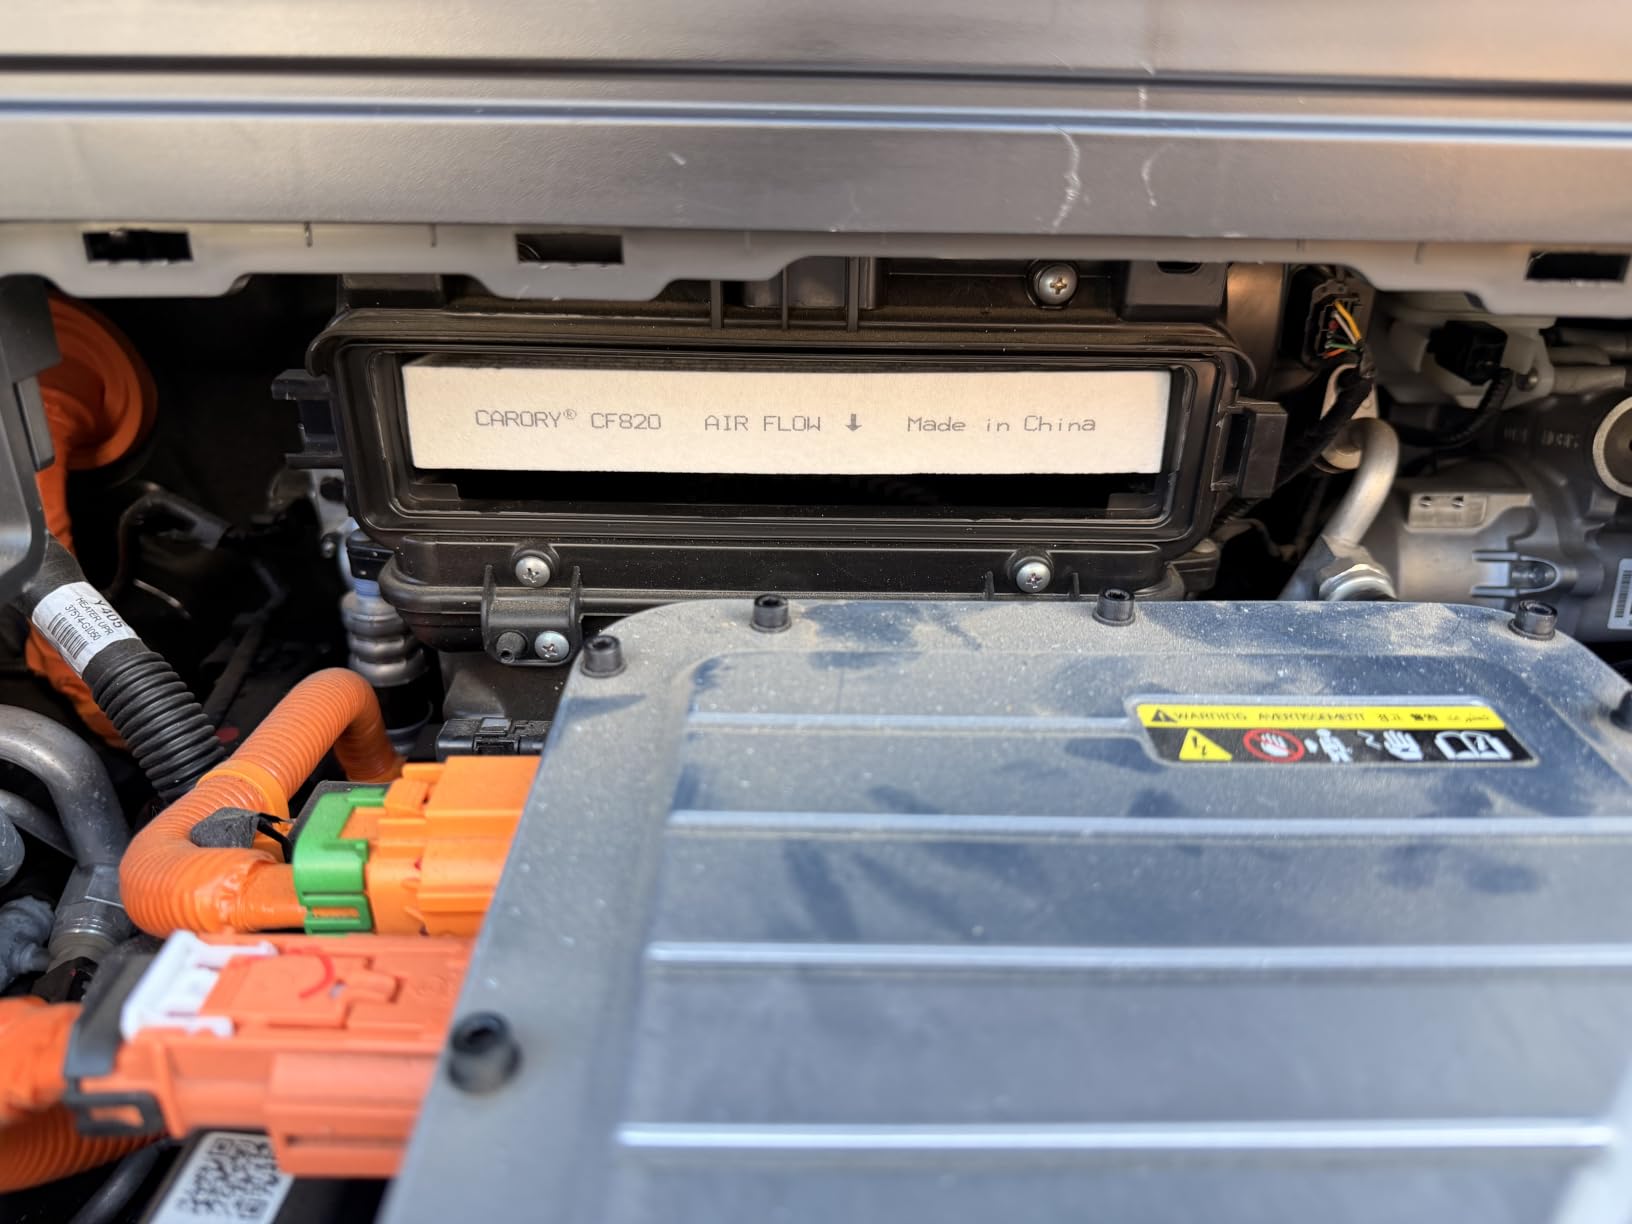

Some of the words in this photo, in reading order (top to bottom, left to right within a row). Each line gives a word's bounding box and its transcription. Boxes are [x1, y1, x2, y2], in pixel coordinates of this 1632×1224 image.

[590, 412, 662, 430] CF820
[704, 414, 749, 432] AIR
[763, 415, 821, 432] FLOW
[907, 416, 966, 432] Made
[986, 418, 1010, 432] in
[1023, 415, 1097, 432] China
[76, 598, 101, 622] HEATER
[97, 618, 114, 635] UPR
[94, 600, 123, 628] Y405
